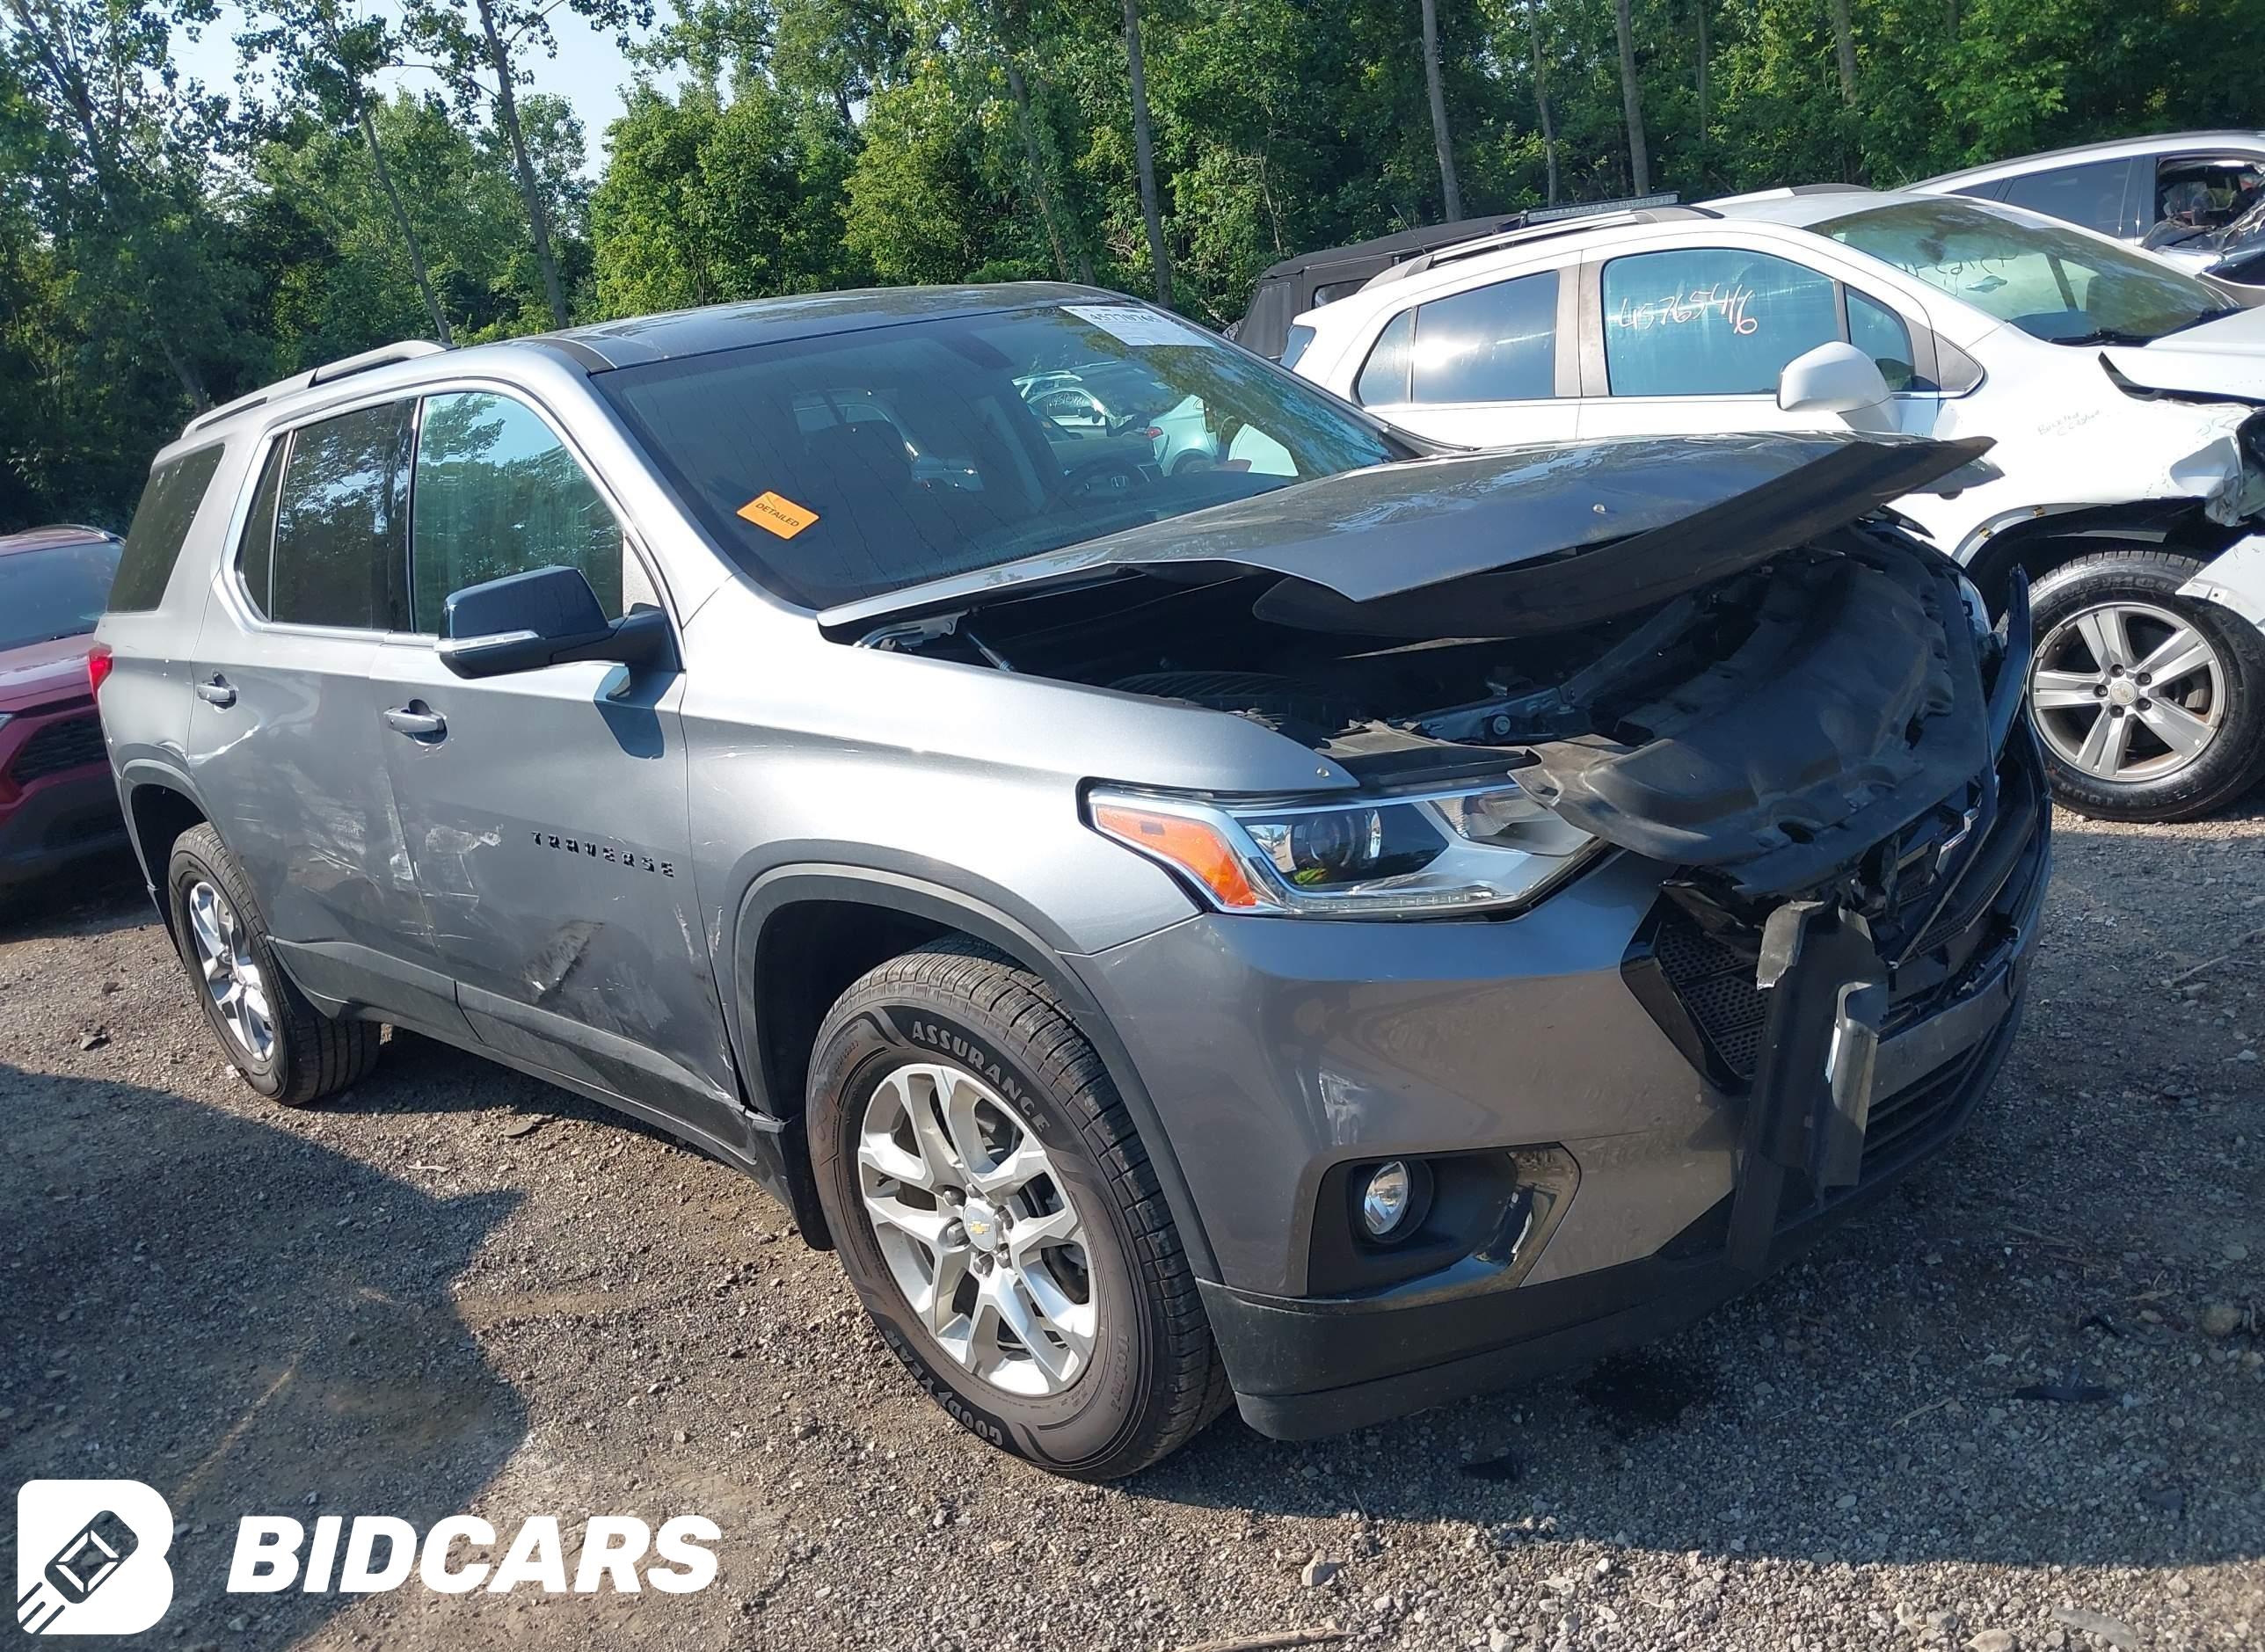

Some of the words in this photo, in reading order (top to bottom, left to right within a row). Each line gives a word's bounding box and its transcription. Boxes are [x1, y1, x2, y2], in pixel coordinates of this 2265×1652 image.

[755, 502, 800, 528] DETAILED
[531, 831, 675, 878] TRAVERSE
[911, 1020, 1052, 1133] ASSURANCE
[884, 1329, 1003, 1447] GOODYEAR
